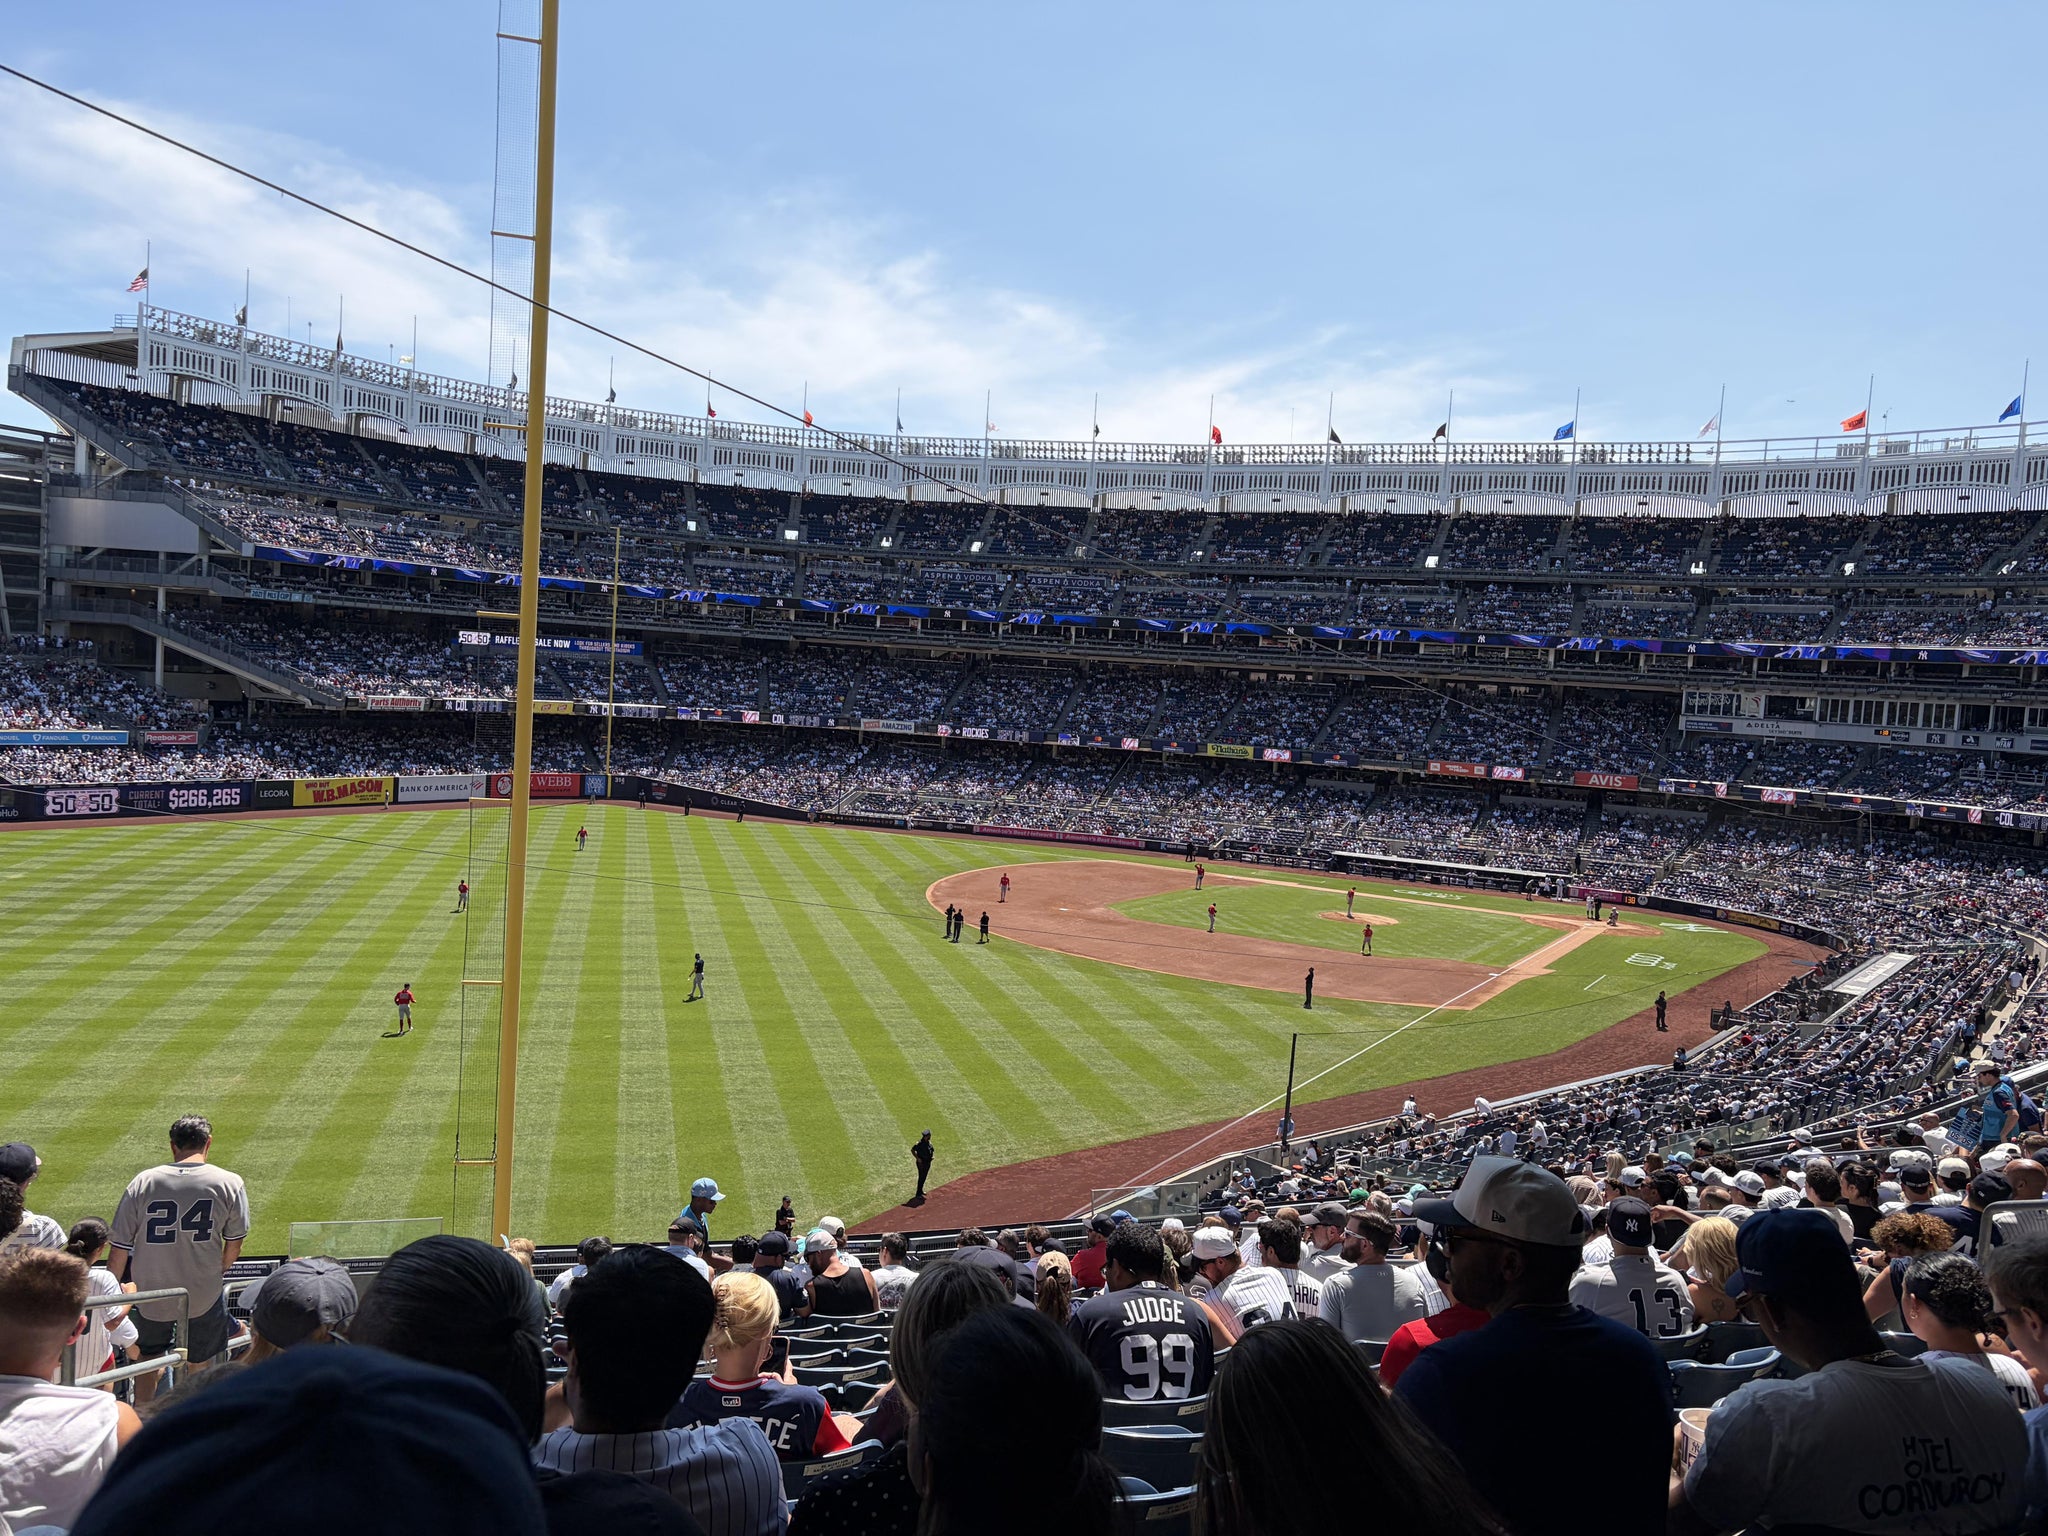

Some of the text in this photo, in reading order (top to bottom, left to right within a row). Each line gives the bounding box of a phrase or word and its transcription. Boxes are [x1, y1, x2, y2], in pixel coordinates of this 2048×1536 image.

[1031, 577, 1101, 587] ASPEN VODKA
[461, 633, 488, 644] 50 50
[535, 638, 551, 648] SALE
[553, 639, 570, 649] NOW
[371, 698, 422, 707] Parts Authority
[455, 701, 468, 711] COL
[772, 714, 784, 724] COL
[882, 722, 912, 731] AMAZING
[146, 734, 177, 742] Reebok
[962, 727, 989, 739] ROCKIES
[305, 781, 318, 789] WHO
[536, 776, 572, 787] WEBB
[1589, 774, 1622, 787] AVIS
[259, 790, 290, 798] LEGORA
[400, 785, 421, 793] BANK
[434, 784, 468, 792] AMERICA
[129, 790, 165, 800] CURRENT
[169, 787, 241, 809] $266,265
[52, 793, 113, 814] 50 50
[133, 800, 161, 808] TOTAL:
[1999, 812, 2014, 826] COL
[146, 1198, 214, 1245] 24
[1625, 1219, 1638, 1232] NY
[1122, 1297, 1186, 1327] JUDGE
[1627, 1288, 1683, 1337] 13
[1120, 1333, 1195, 1400] 99
